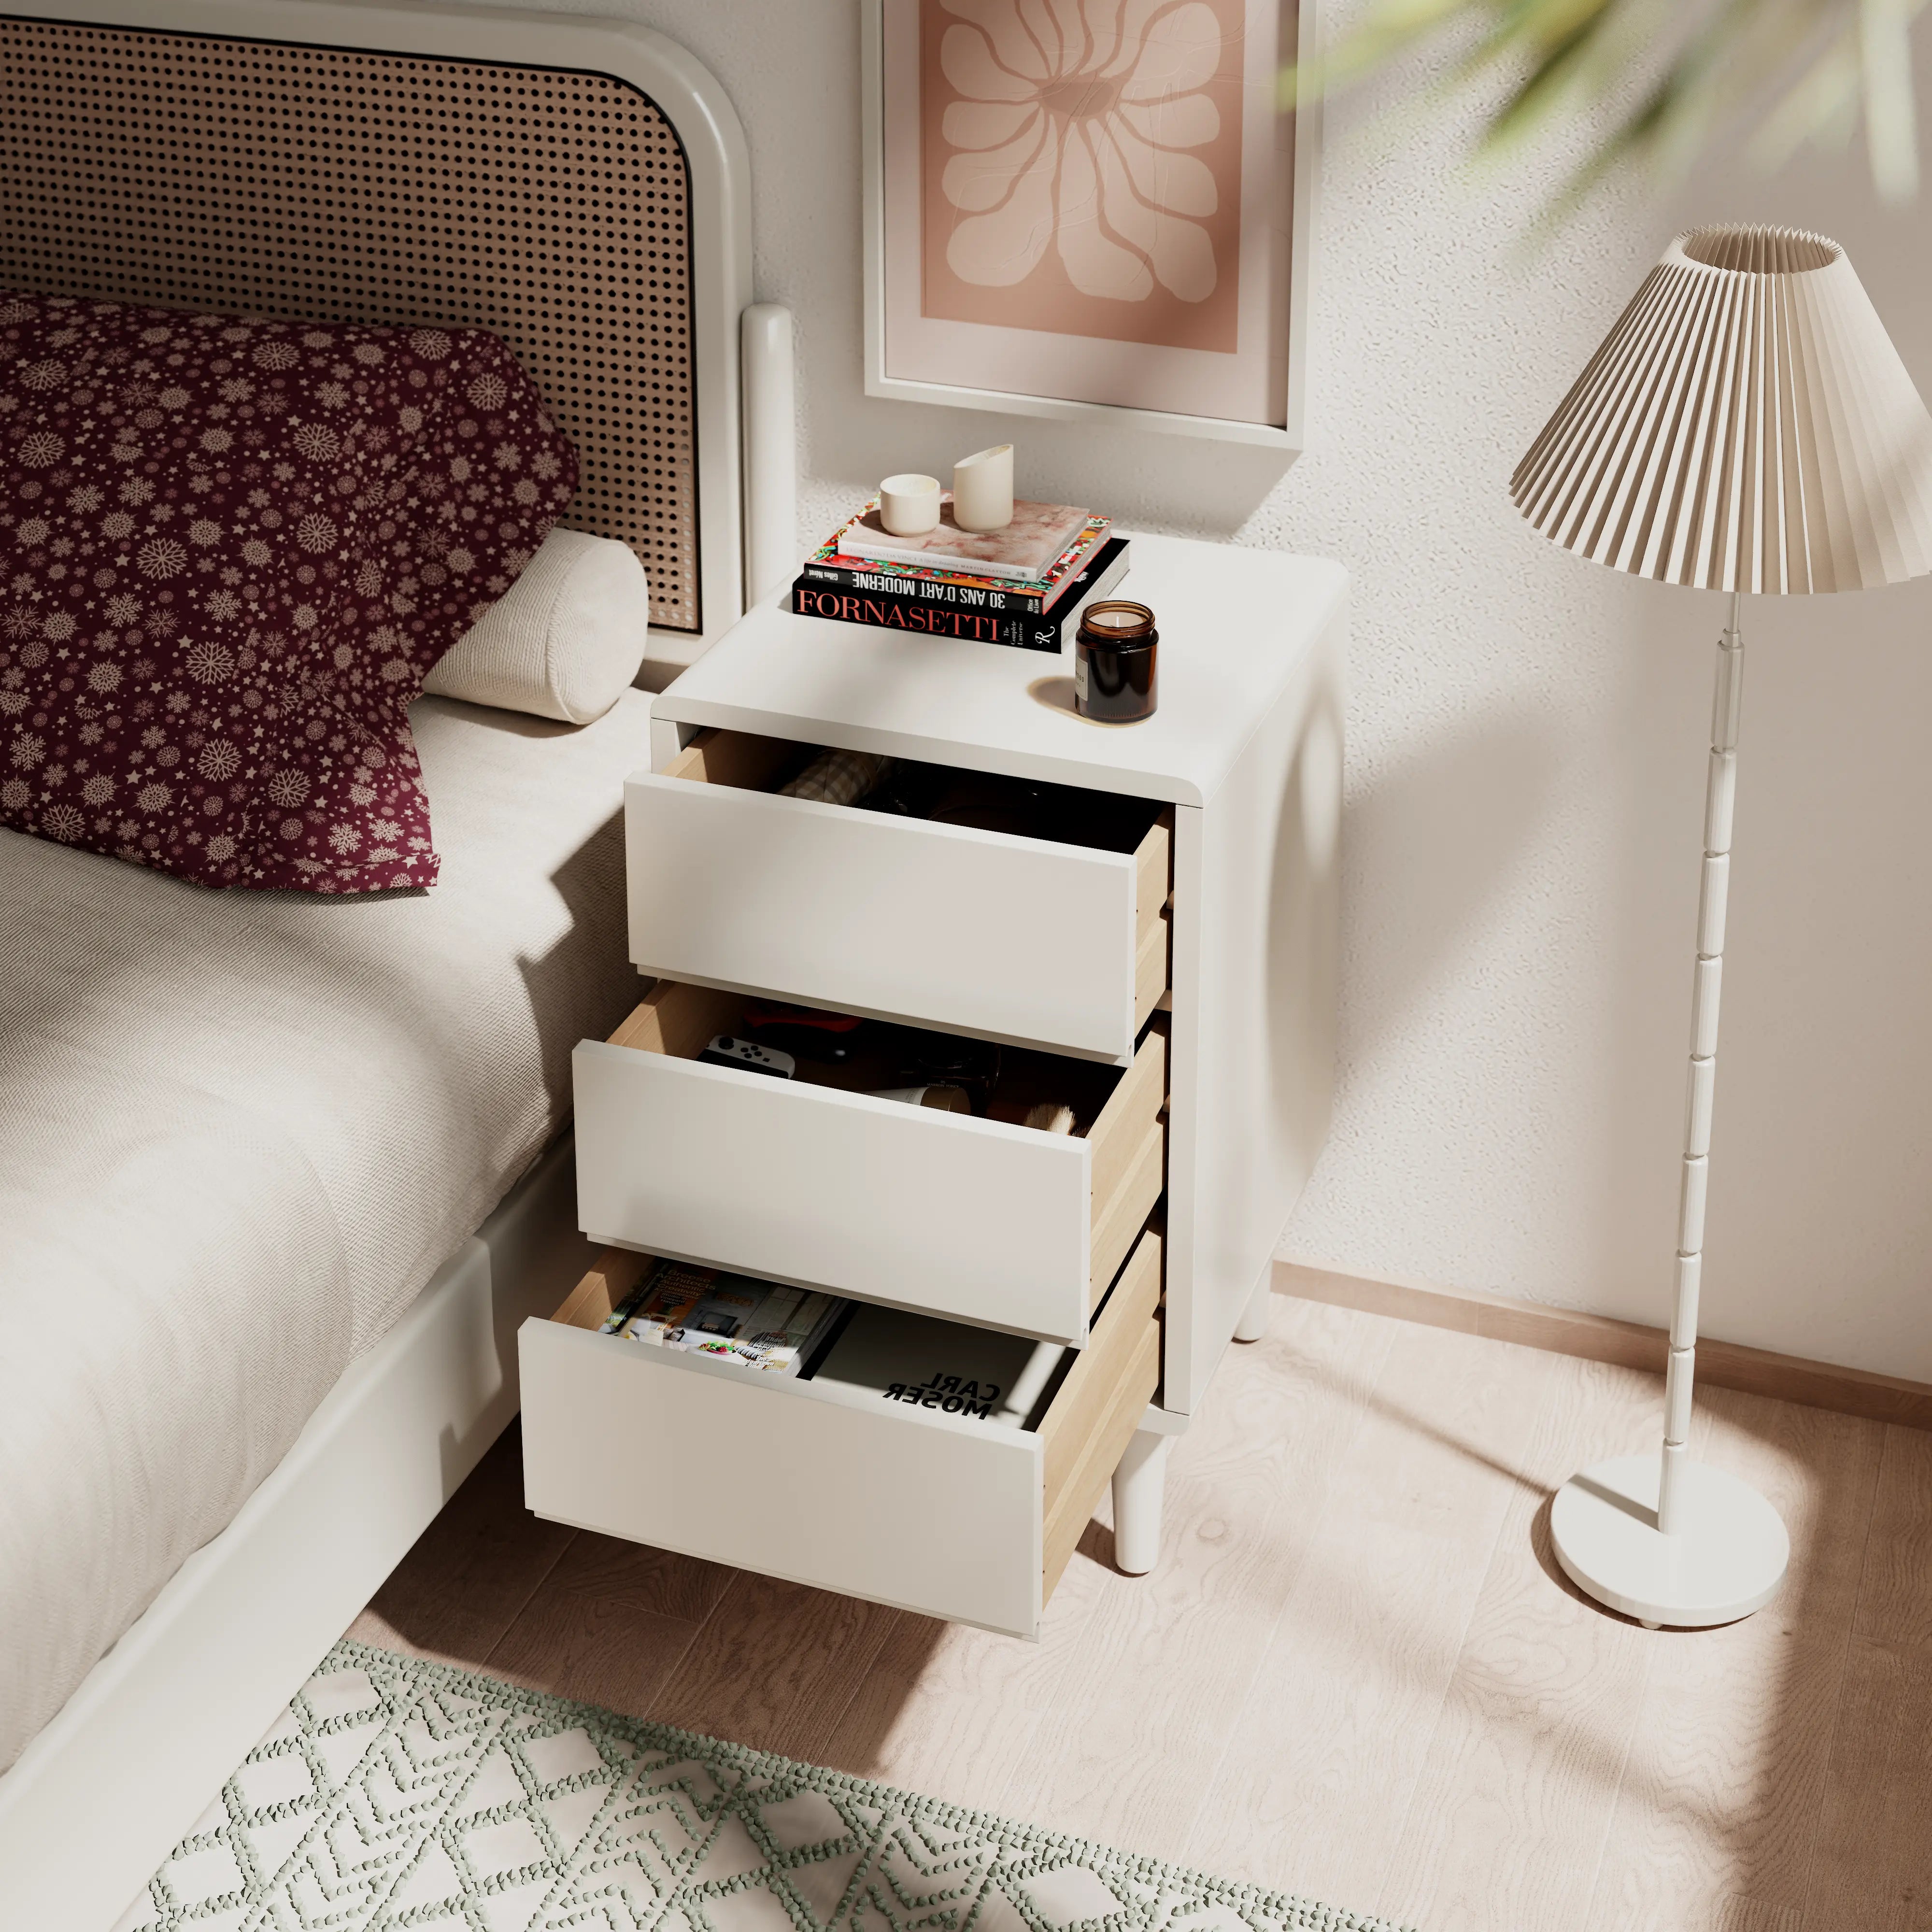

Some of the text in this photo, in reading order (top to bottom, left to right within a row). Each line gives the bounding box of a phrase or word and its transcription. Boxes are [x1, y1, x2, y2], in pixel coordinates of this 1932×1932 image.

[852, 571, 1005, 609] 30 ANS D'ART MODERNE
[797, 589, 1000, 641] FORNASETTI
[1035, 626, 1055, 644] R
[655, 1273, 716, 1290] Architects
[668, 1269, 711, 1283] Breese
[660, 1279, 705, 1292] Authentic
[660, 1295, 685, 1303] Vineyard
